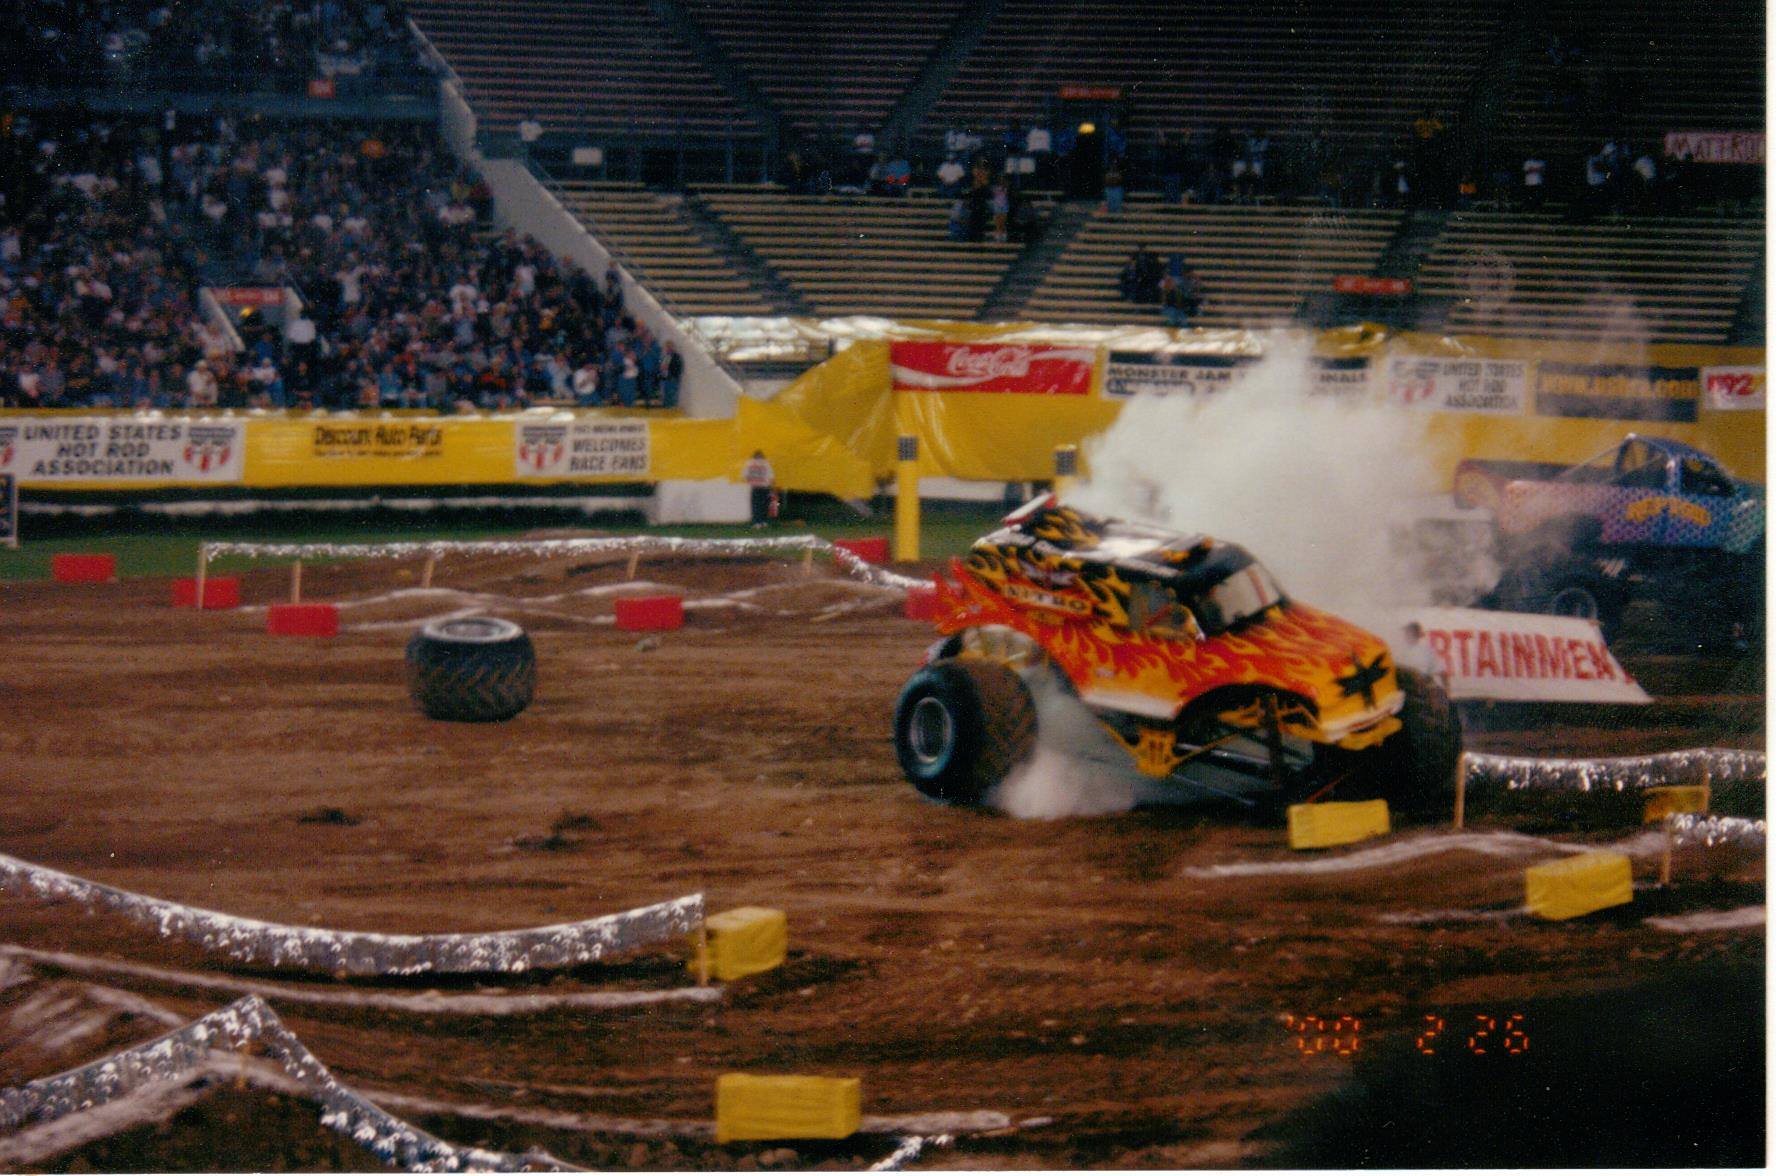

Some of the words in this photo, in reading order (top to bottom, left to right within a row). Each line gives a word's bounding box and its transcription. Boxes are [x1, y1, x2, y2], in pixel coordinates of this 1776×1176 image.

[1108, 367, 1188, 380] MONSTER
[1196, 369, 1231, 381] JAM
[24, 425, 99, 440] UNITED
[109, 425, 182, 440] STATES
[375, 424, 405, 445] Auto
[57, 443, 98, 457] HOT
[106, 443, 150, 457] ROD
[572, 438, 645, 453] WELCOMES
[33, 460, 175, 475] ASSOCIATION
[570, 455, 605, 471] RACE
[612, 454, 647, 470] FANS
